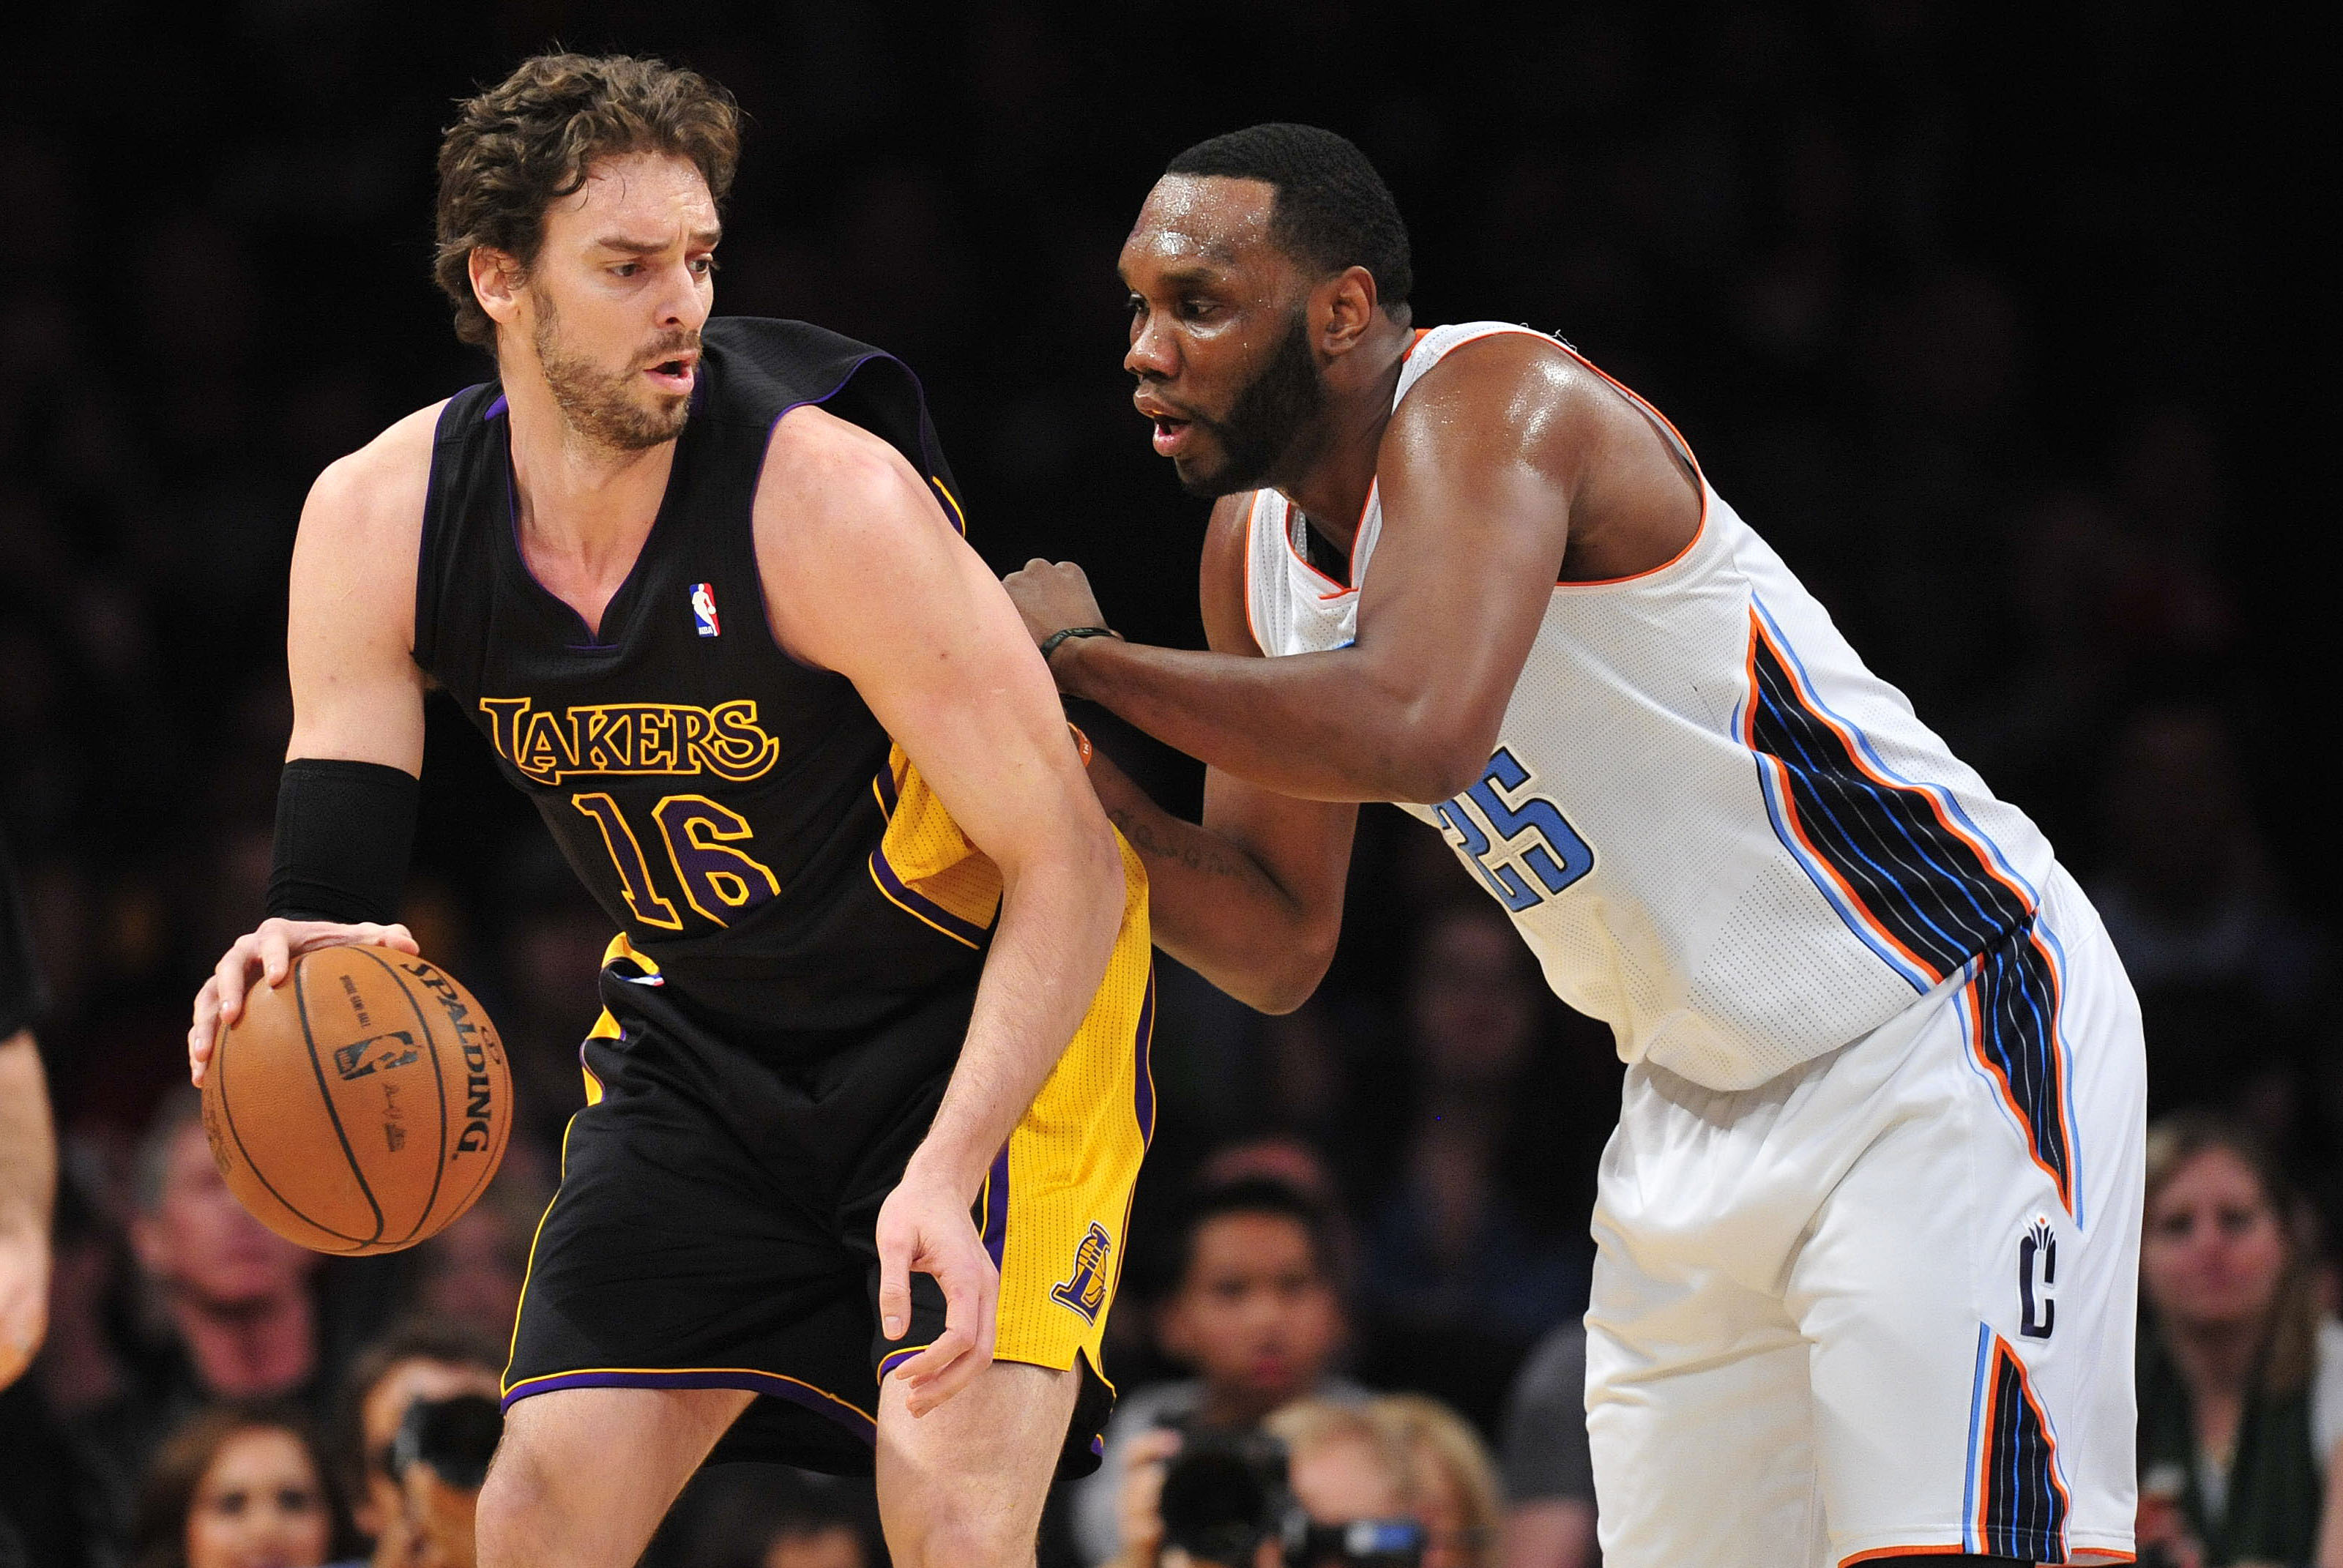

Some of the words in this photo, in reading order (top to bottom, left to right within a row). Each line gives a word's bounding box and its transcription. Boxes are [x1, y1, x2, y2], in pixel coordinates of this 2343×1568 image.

[480, 697, 779, 785] LAKERS
[571, 793, 781, 930] 16
[1429, 745, 1595, 913] 25
[401, 963, 492, 1151] SPALDING
